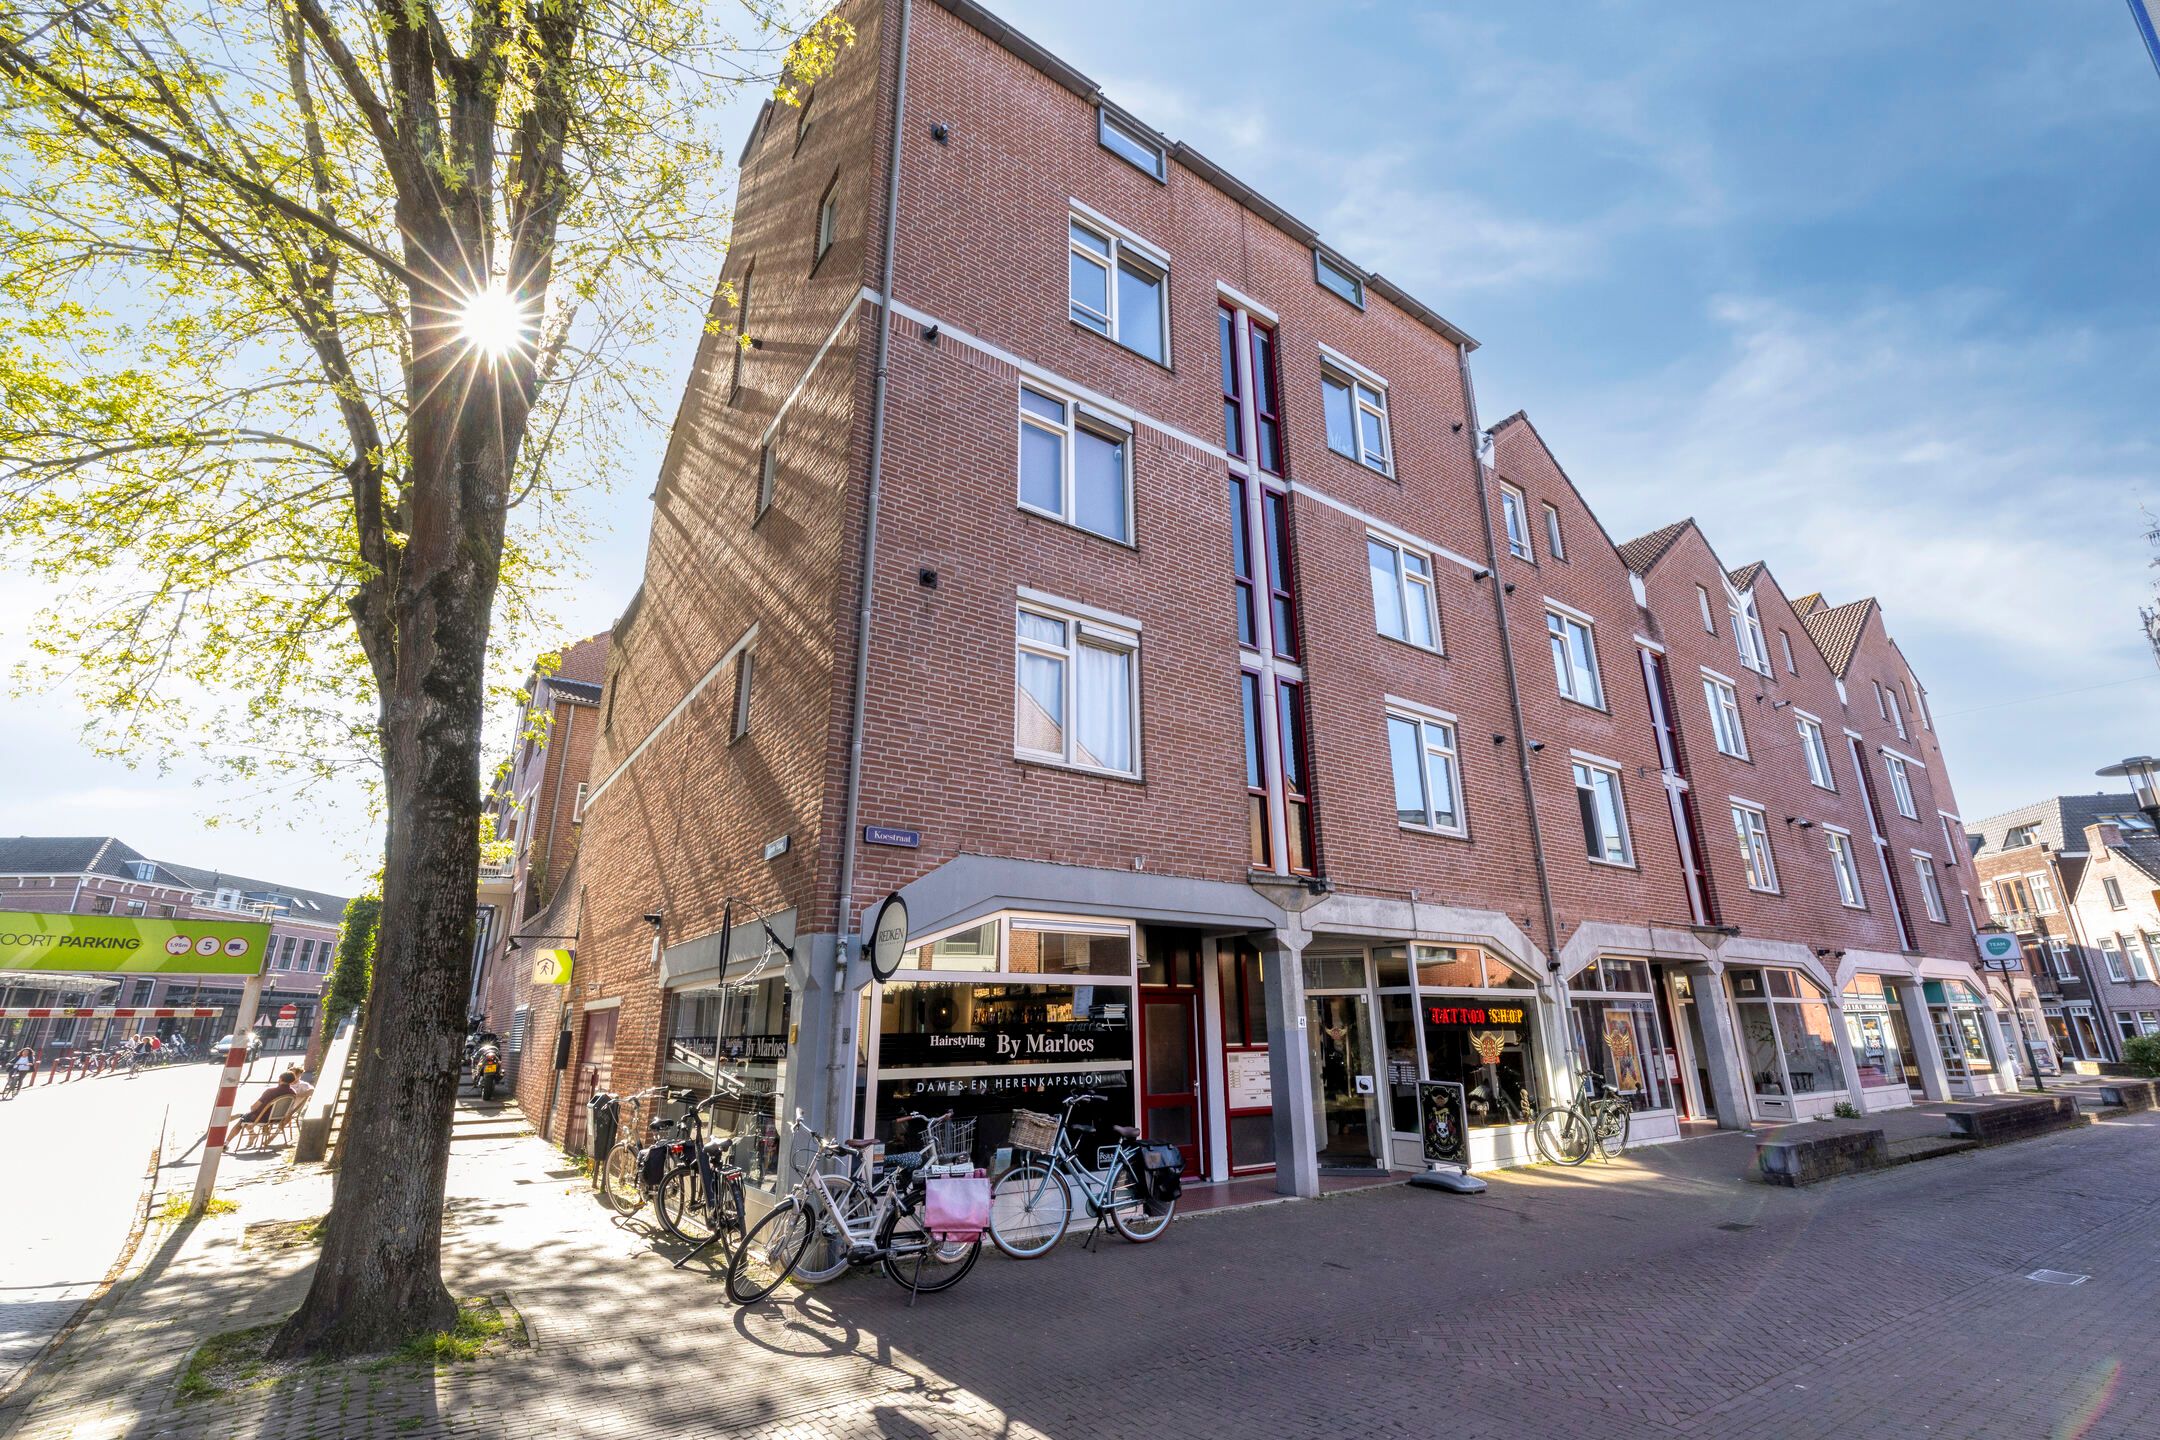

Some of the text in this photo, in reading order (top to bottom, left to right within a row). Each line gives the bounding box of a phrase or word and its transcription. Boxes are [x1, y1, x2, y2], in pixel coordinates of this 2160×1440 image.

[874, 831, 911, 843] Koestraat
[58, 935, 140, 950] PARKING
[879, 928, 905, 942] REDKEN
[203, 941, 213, 950] 5
[1430, 1008, 1524, 1024] TATTOO SHOP
[745, 1038, 755, 1061] By
[756, 1037, 786, 1057] Marloes
[930, 1034, 1095, 1059] Hairstyling By Marloes
[995, 1074, 1102, 1089] HERENKAPSALON
